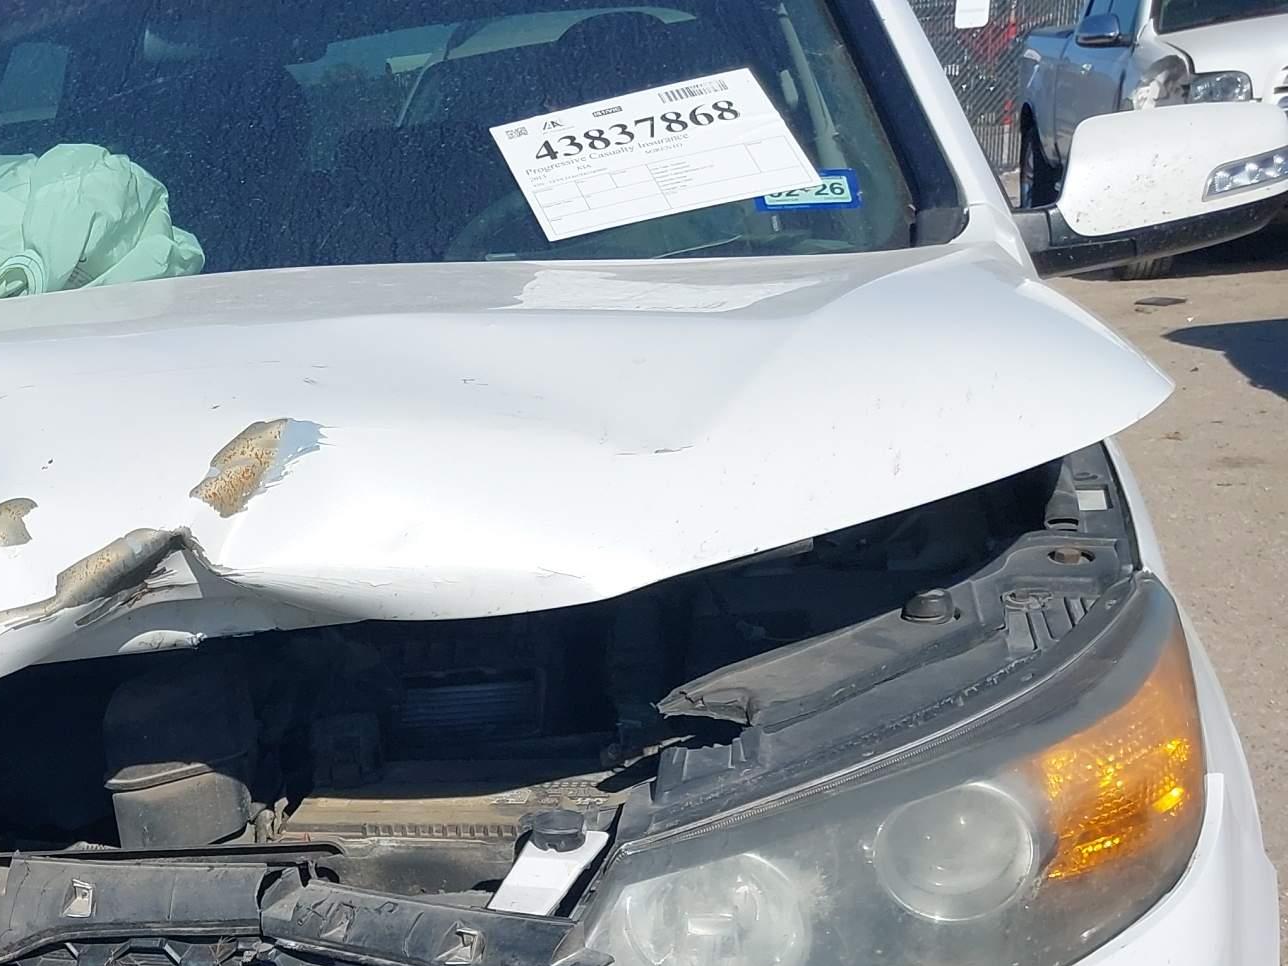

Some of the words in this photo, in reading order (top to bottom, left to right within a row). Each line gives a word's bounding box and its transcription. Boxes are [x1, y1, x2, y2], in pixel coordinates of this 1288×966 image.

[535, 100, 741, 160] 43837868
[525, 156, 587, 176] Progressive
[588, 145, 634, 160] Casualty
[638, 133, 689, 149] Insurance
[814, 182, 845, 196] 26
